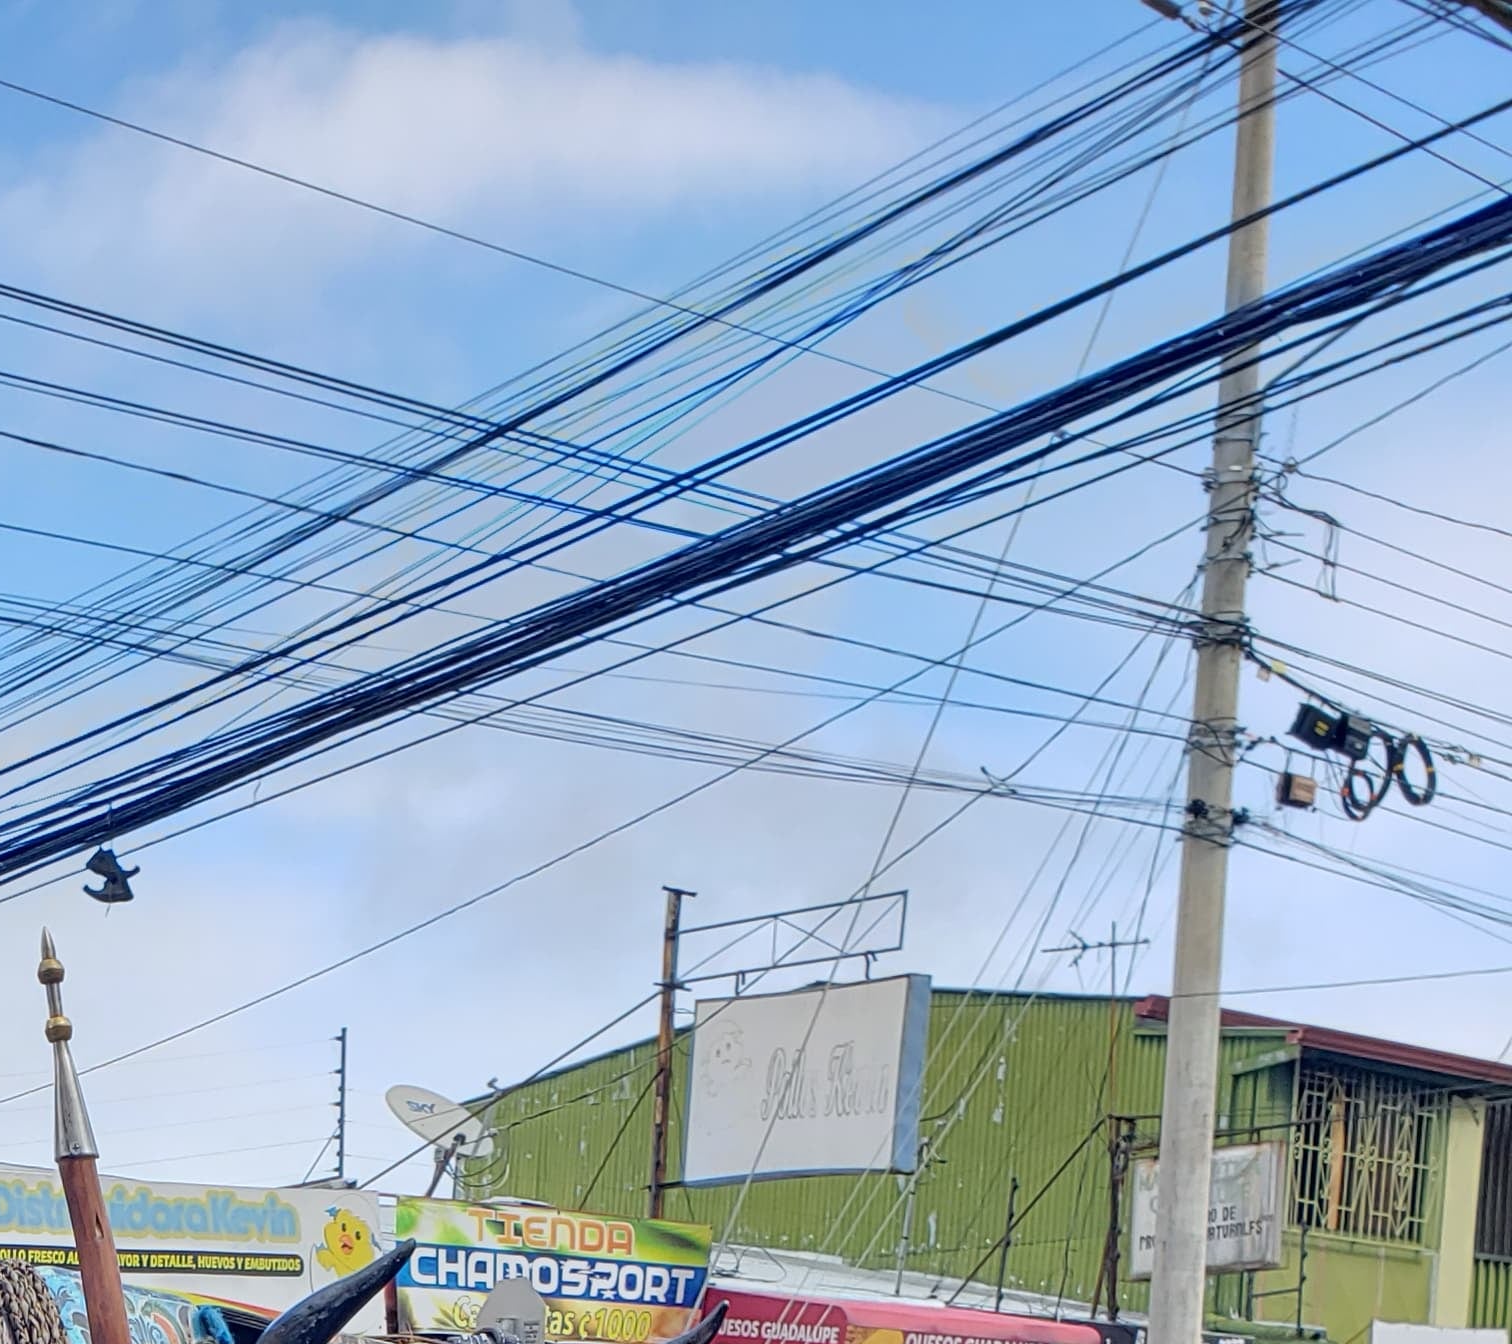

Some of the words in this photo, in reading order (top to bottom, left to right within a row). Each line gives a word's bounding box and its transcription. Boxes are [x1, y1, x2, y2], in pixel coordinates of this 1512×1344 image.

[207, 1189, 300, 1241] Kevin
[467, 1208, 635, 1256] TIENDA
[28, 1249, 66, 1265] FRESCO
[67, 1251, 80, 1265] AL
[141, 1255, 150, 1267] Y
[150, 1255, 196, 1270] DETALLE,
[197, 1255, 236, 1270] HUEVOS
[237, 1257, 245, 1270] Y
[245, 1257, 301, 1272] EMBUTIDOS
[409, 1246, 695, 1304] CHAMOSPORT
[761, 1321, 840, 1344] GUADALUPE
